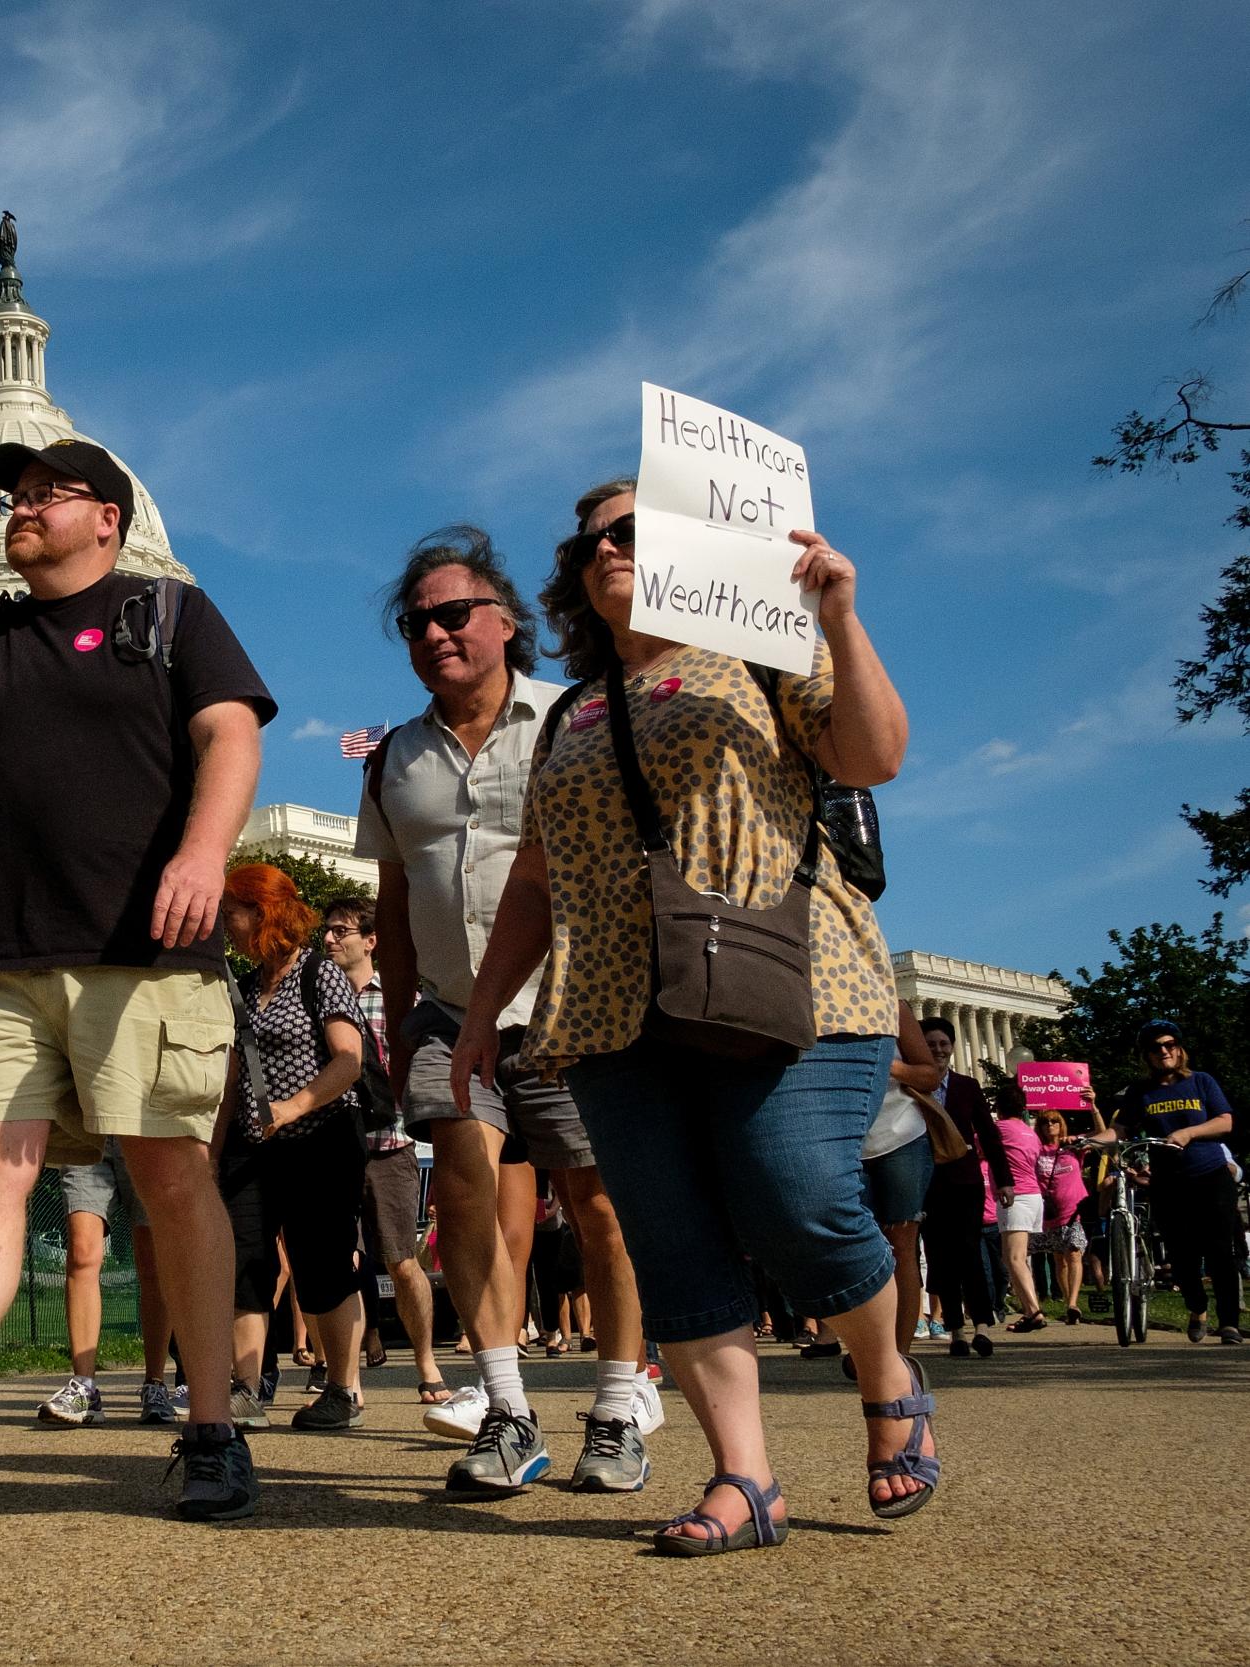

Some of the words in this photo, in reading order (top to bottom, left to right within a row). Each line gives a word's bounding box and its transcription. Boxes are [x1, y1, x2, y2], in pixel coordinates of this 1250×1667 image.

[659, 391, 805, 481] Healthcare
[709, 479, 784, 527] Not
[638, 563, 809, 640] Wealthcare
[1021, 1074, 1046, 1083] Don't
[1047, 1074, 1070, 1083] Take
[1022, 1084, 1047, 1094] Away
[1048, 1084, 1065, 1093] Our
[1066, 1084, 1083, 1093] Car
[1144, 1099, 1202, 1115] MICHIGAN
